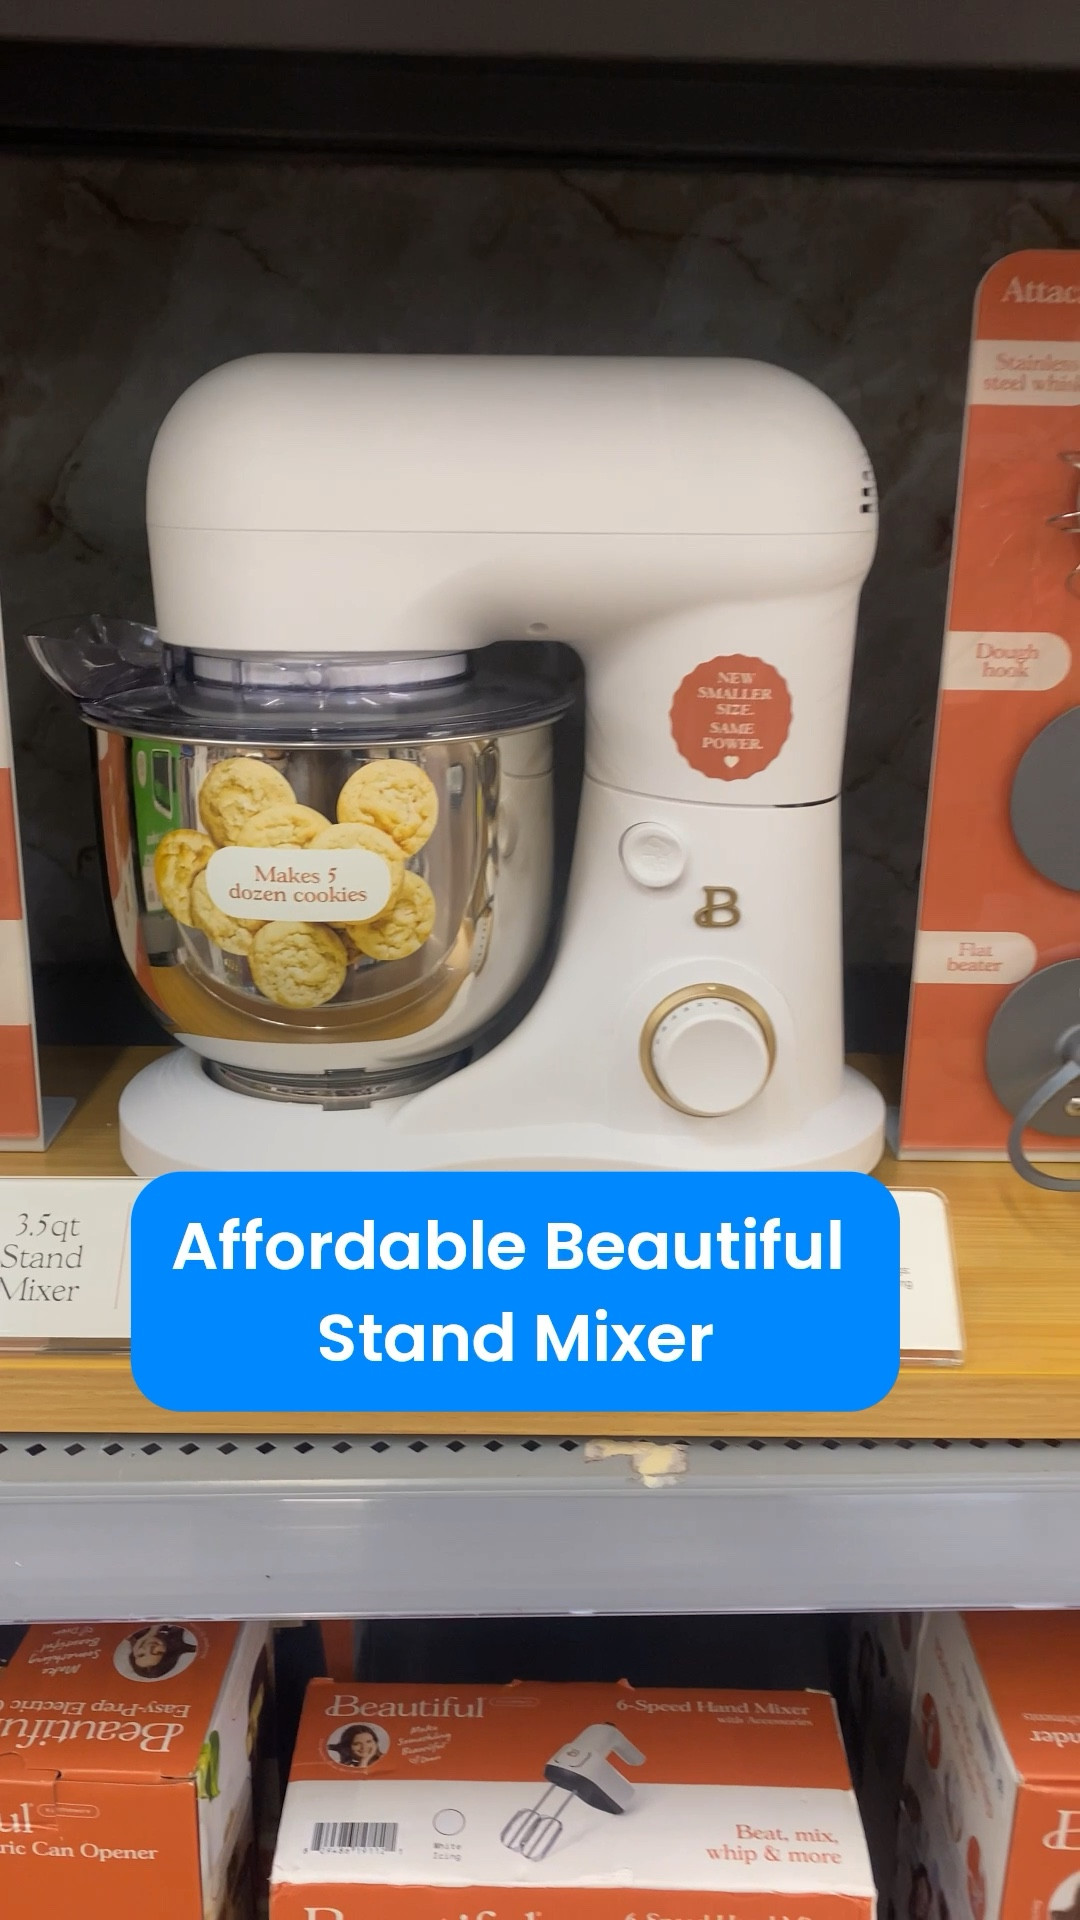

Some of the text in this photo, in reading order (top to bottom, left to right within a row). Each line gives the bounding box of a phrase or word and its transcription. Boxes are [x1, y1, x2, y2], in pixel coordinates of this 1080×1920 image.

[975, 642, 1040, 664] Dough
[717, 671, 756, 684] NEW
[982, 661, 1030, 678] hook
[697, 686, 773, 700] SMALLER
[709, 721, 756, 735] SAME
[255, 865, 338, 883] Makes 5
[228, 883, 368, 903] dozen cookies
[693, 886, 741, 928] B
[959, 942, 993, 957] Flat
[947, 957, 1003, 972] beater
[16, 1212, 81, 1243] 3.5qt
[0, 1243, 83, 1269] Stand
[10, 1699, 191, 1718] Easy-Prep Electric
[325, 1694, 484, 1718] Beautiful
[616, 1699, 810, 1716] 6-Speed Hand Mixer
[735, 1823, 840, 1844] Beat, mix,
[31, 1840, 75, 1858] Can
[79, 1842, 159, 1862] Opener
[433, 1842, 462, 1850] White
[705, 1844, 843, 1865] whip & more
[433, 1852, 462, 1862] Icing
